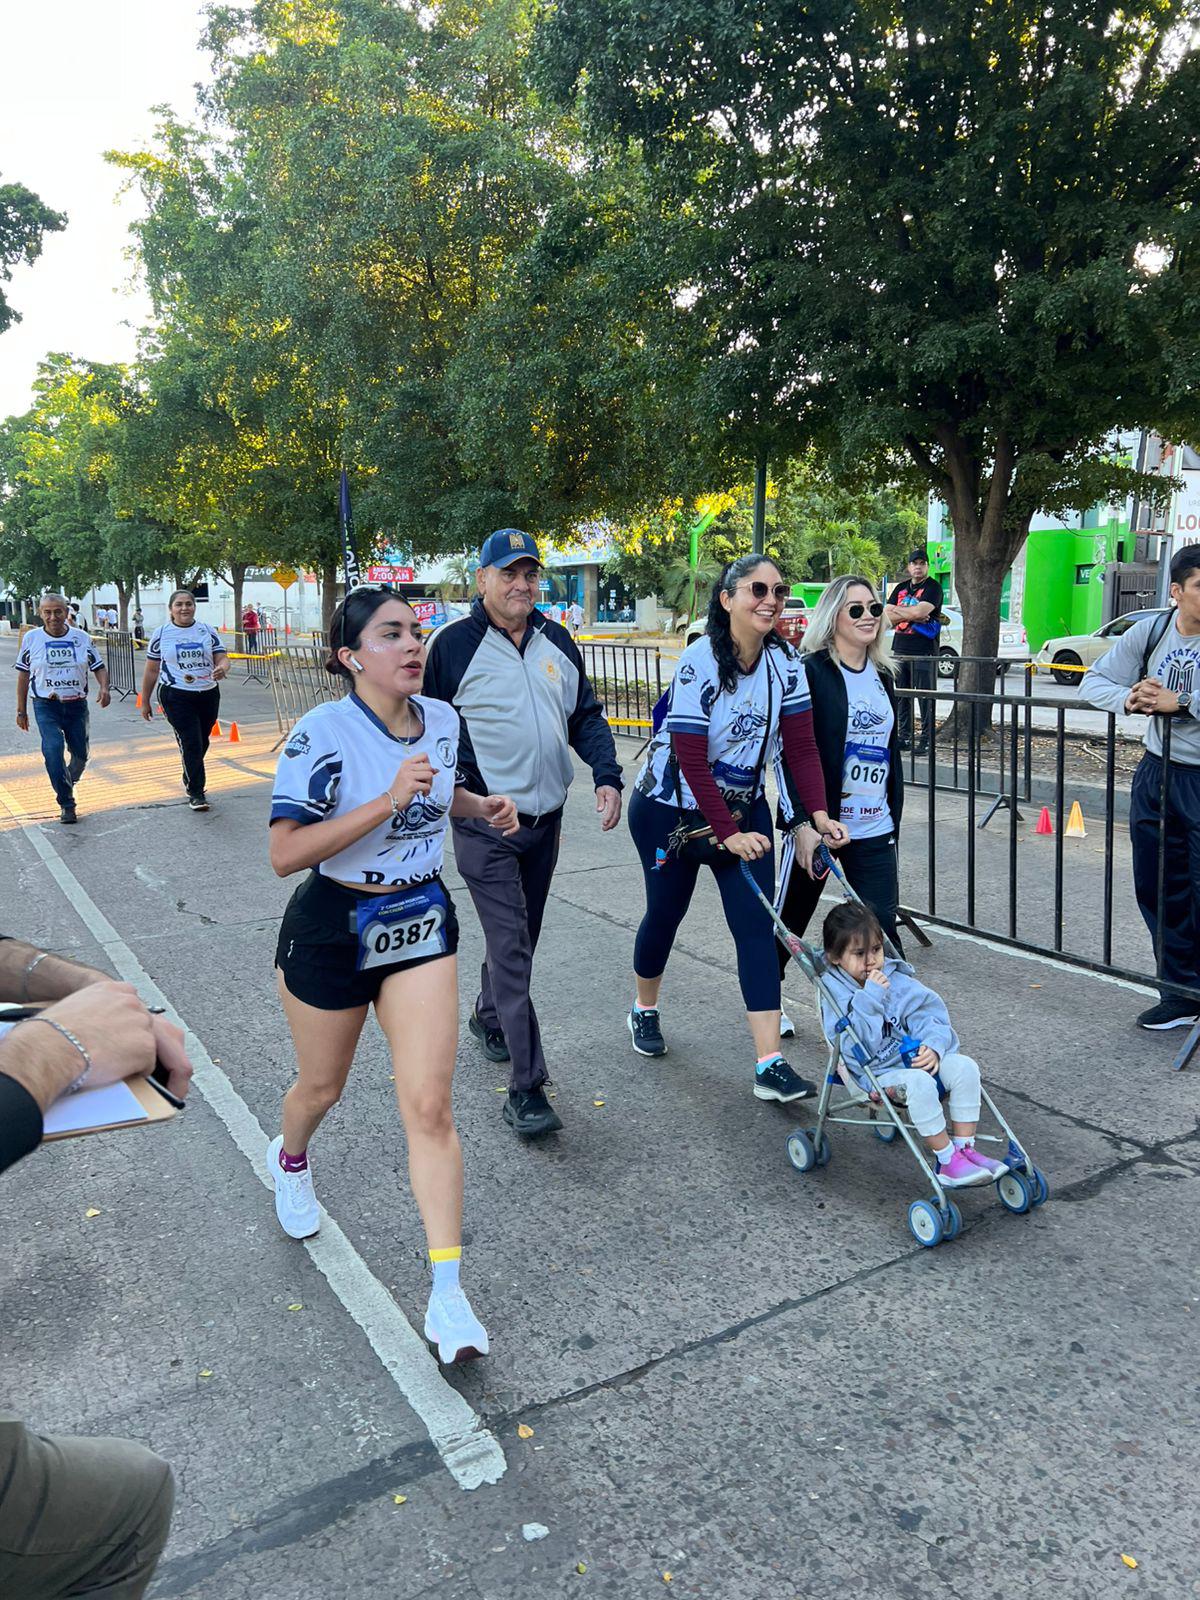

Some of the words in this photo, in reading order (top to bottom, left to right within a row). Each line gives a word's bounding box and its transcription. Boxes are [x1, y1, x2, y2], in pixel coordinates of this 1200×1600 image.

[1177, 514, 1200, 530] LO
[373, 572, 393, 580] 7:00
[50, 650, 72, 658] 0193
[181, 650, 202, 658] 0189
[851, 765, 886, 784] 0167
[375, 917, 436, 954] 0387
